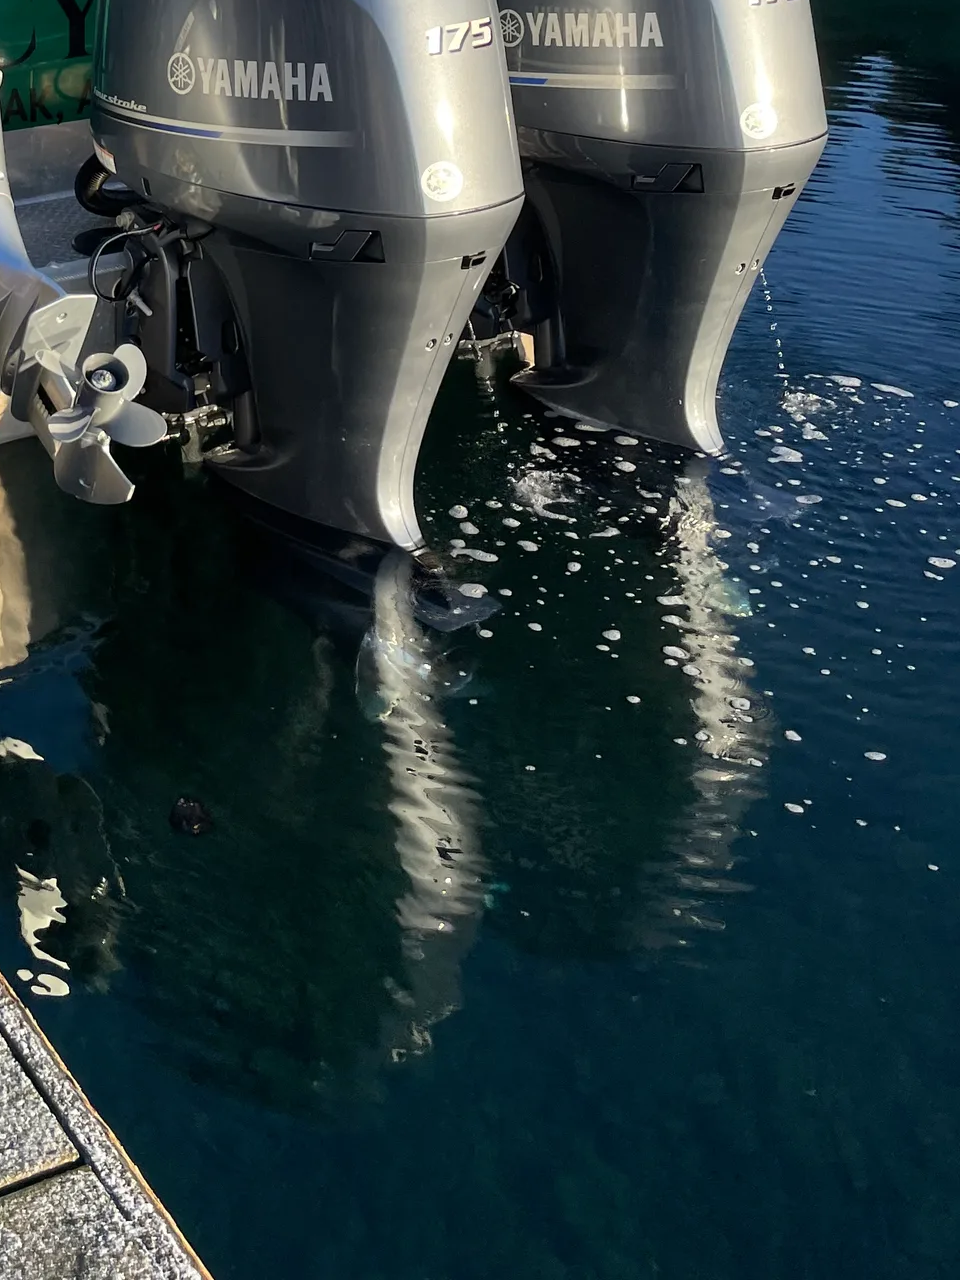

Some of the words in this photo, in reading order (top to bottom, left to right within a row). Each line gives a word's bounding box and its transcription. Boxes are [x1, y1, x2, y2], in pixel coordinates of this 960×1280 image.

[425, 17, 492, 56] 175
[526, 11, 664, 48] YAMAHA
[196, 55, 333, 103] YAMAHA
